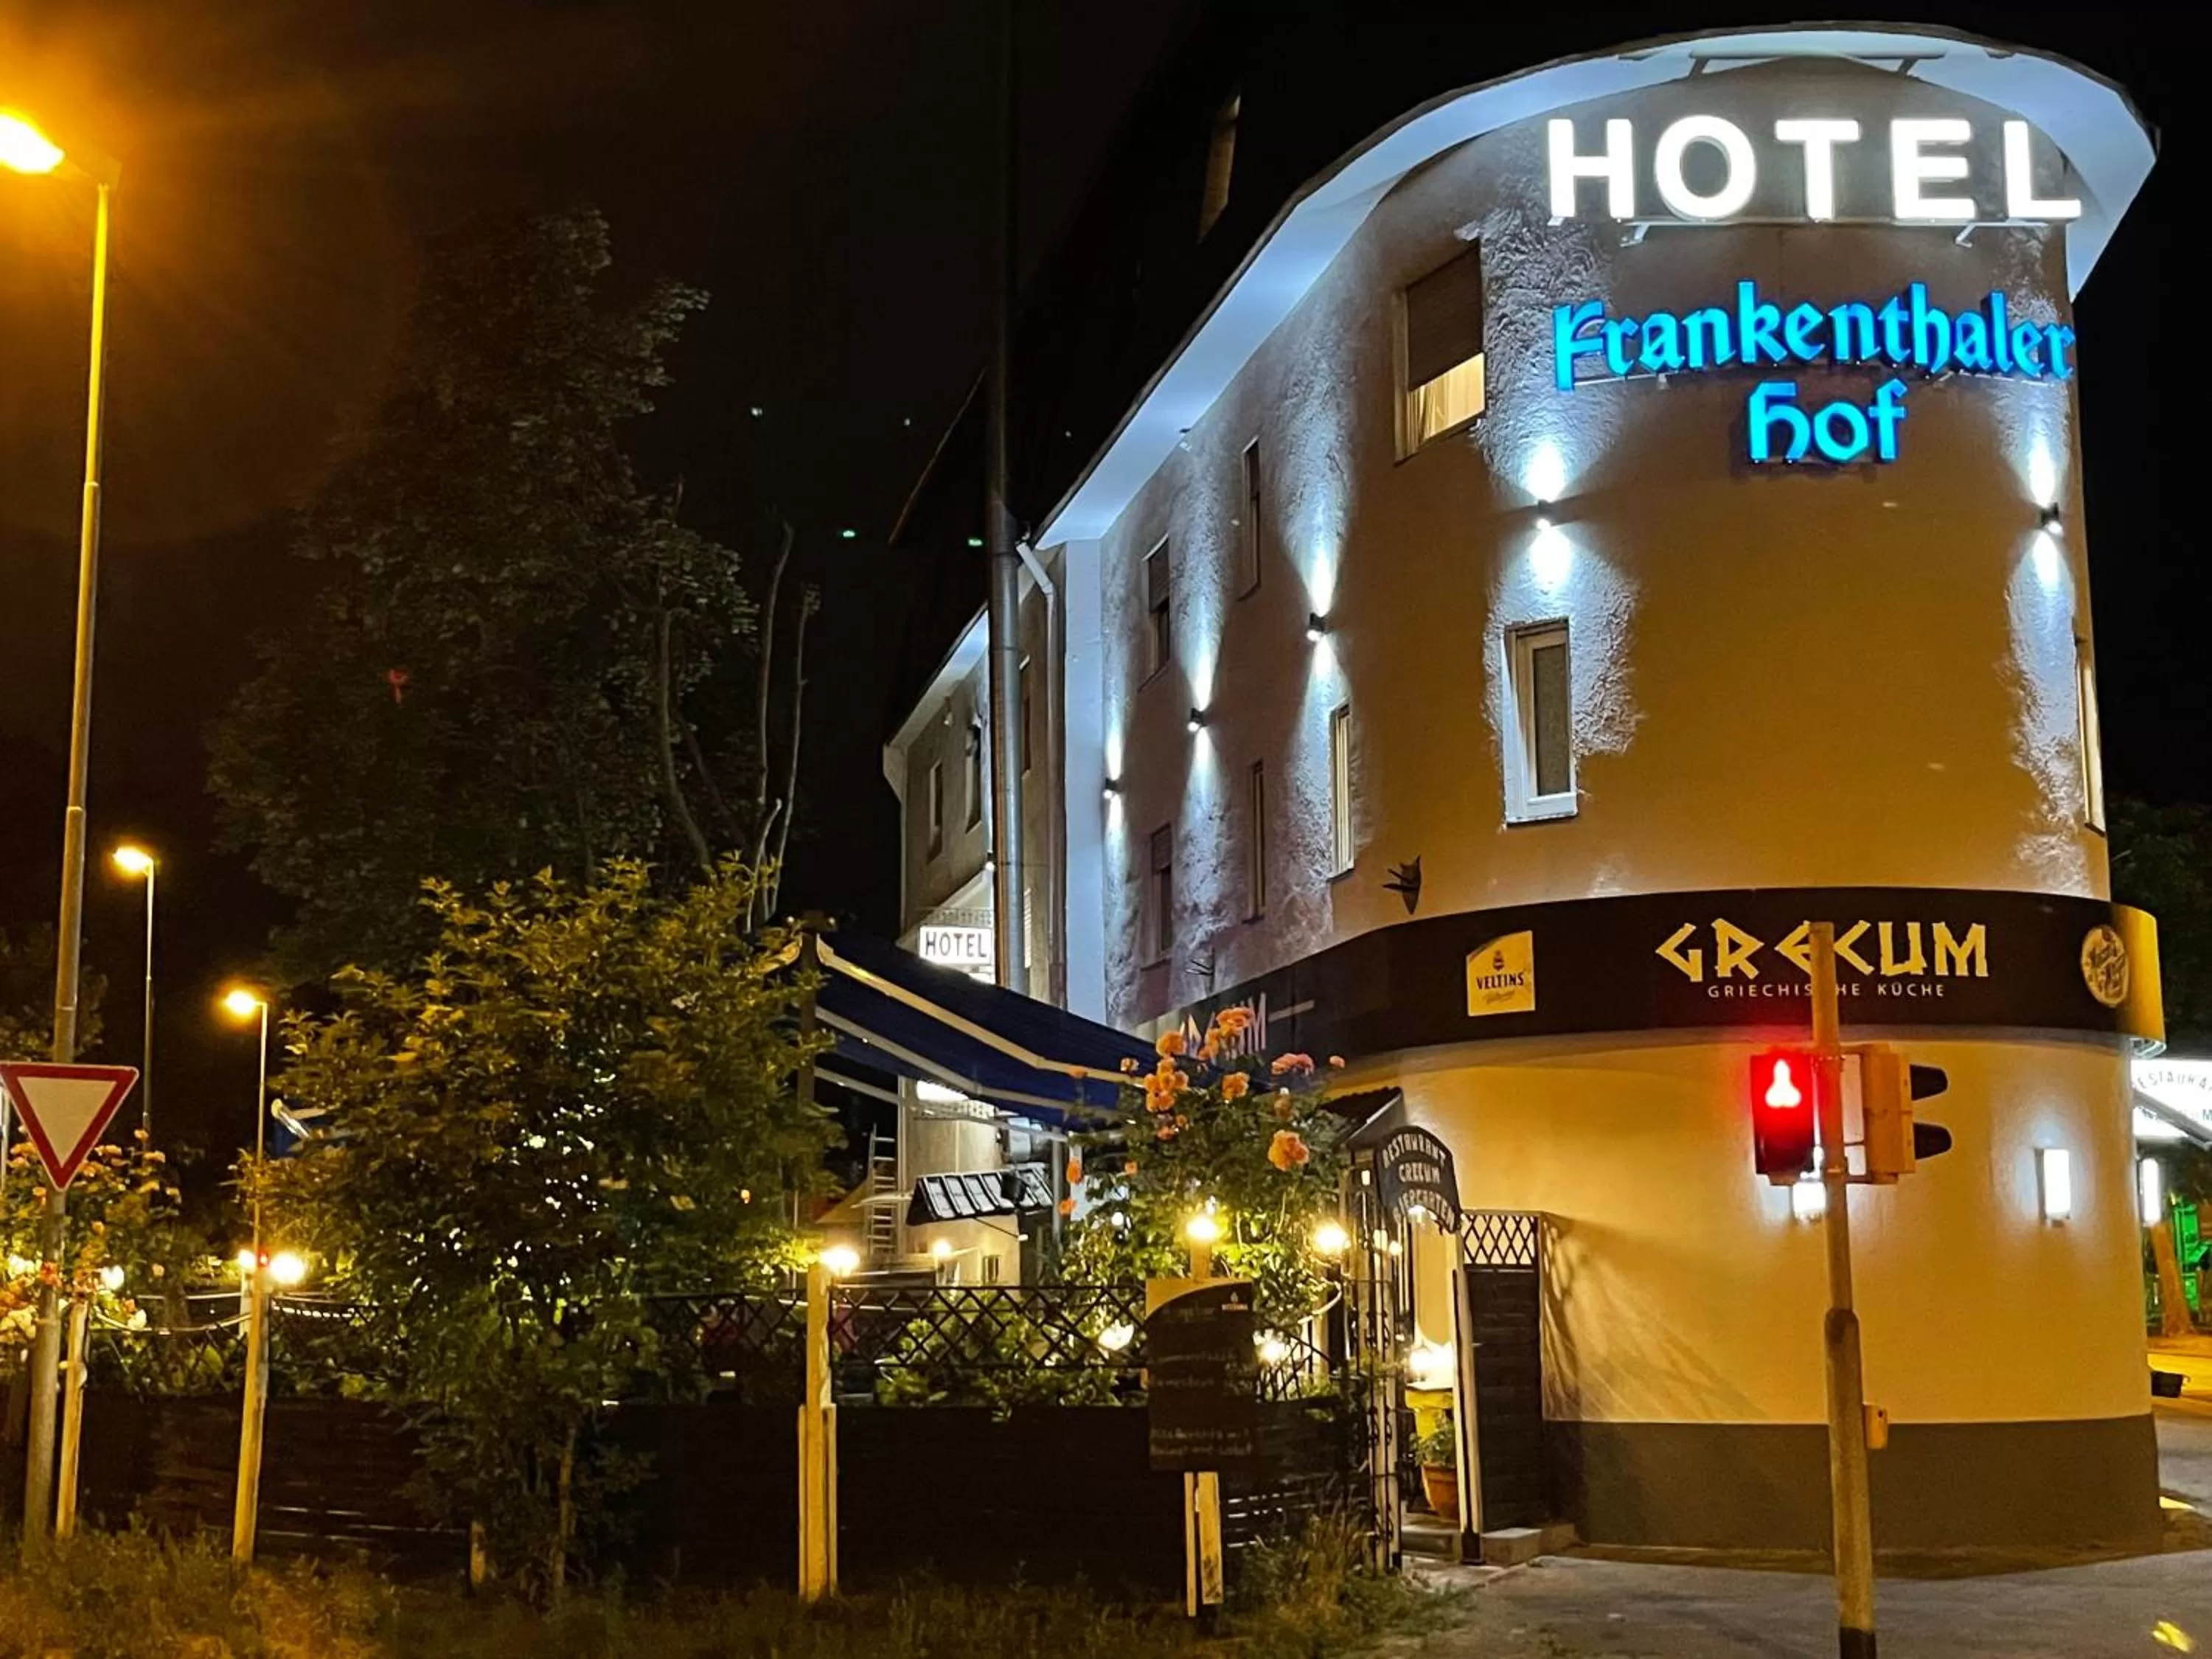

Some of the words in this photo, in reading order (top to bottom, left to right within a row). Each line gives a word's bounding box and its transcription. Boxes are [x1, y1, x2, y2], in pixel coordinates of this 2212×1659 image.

[1548, 115, 2081, 220] HOTEL
[1552, 279, 2073, 391] Frankenthaler
[925, 931, 987, 958] HOTEL
[1476, 972, 1524, 990] VELTINS
[1707, 983, 1860, 998] GRIECHISHE
[1877, 981, 1944, 997] KÜCHE
[2137, 1070, 2212, 1091] ESTAURA
[1382, 1133, 1446, 1169] RESTAURANT
